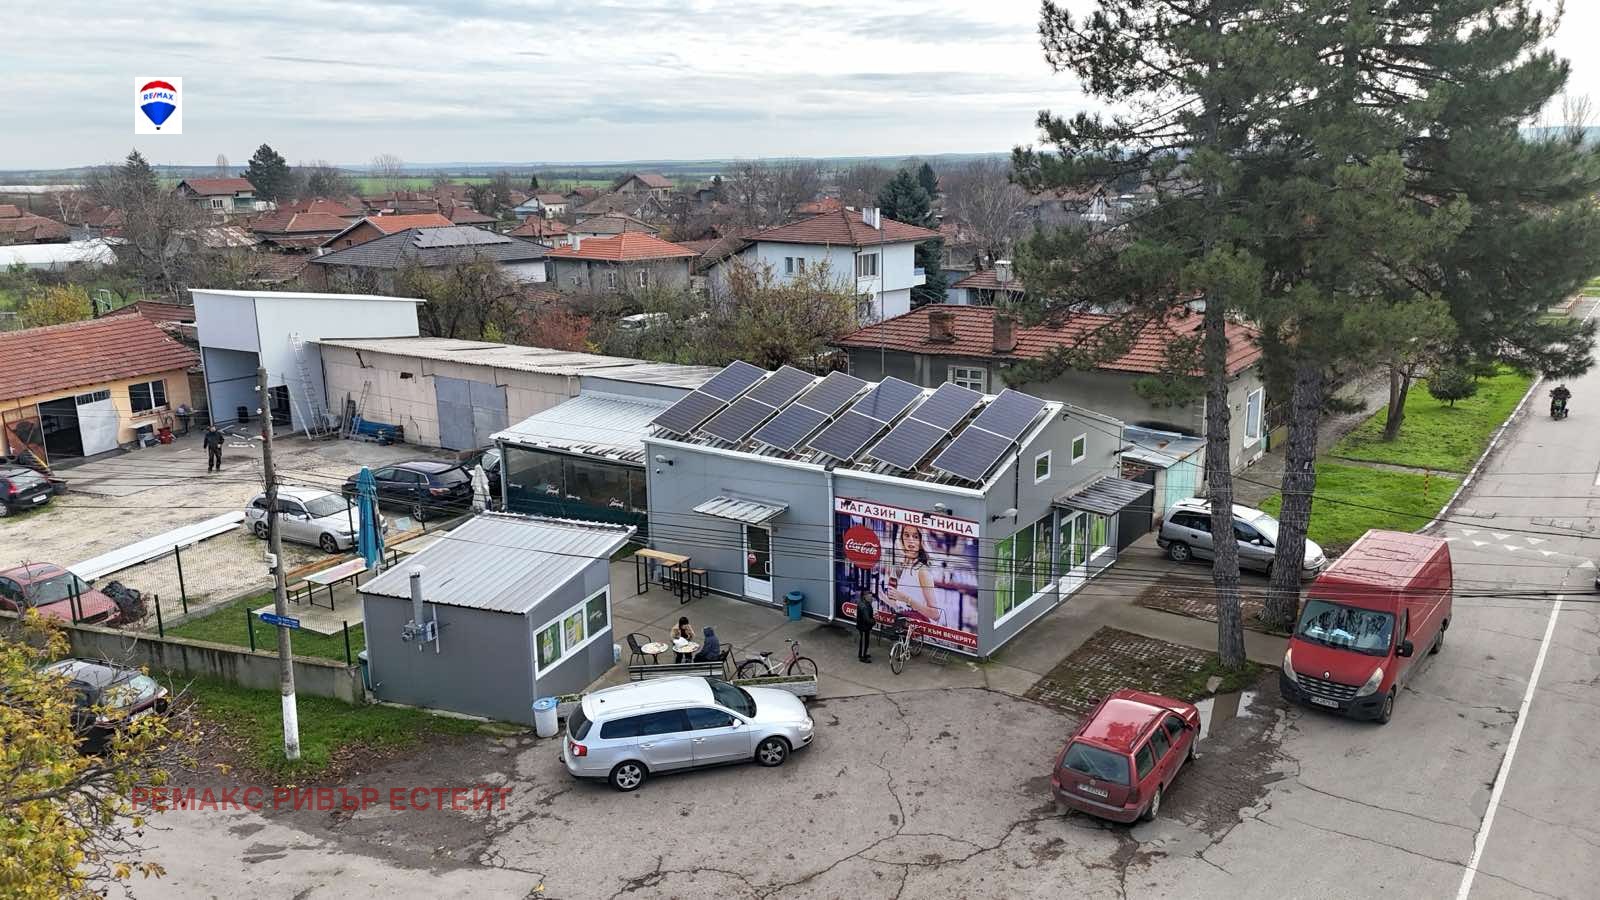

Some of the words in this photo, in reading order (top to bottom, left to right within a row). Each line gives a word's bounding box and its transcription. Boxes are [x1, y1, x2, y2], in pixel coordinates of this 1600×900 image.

[840, 501, 896, 519] МАГАЗИН
[904, 512, 974, 535] ЦВЕТНИЦА
[845, 538, 880, 555] Coca-Cola
